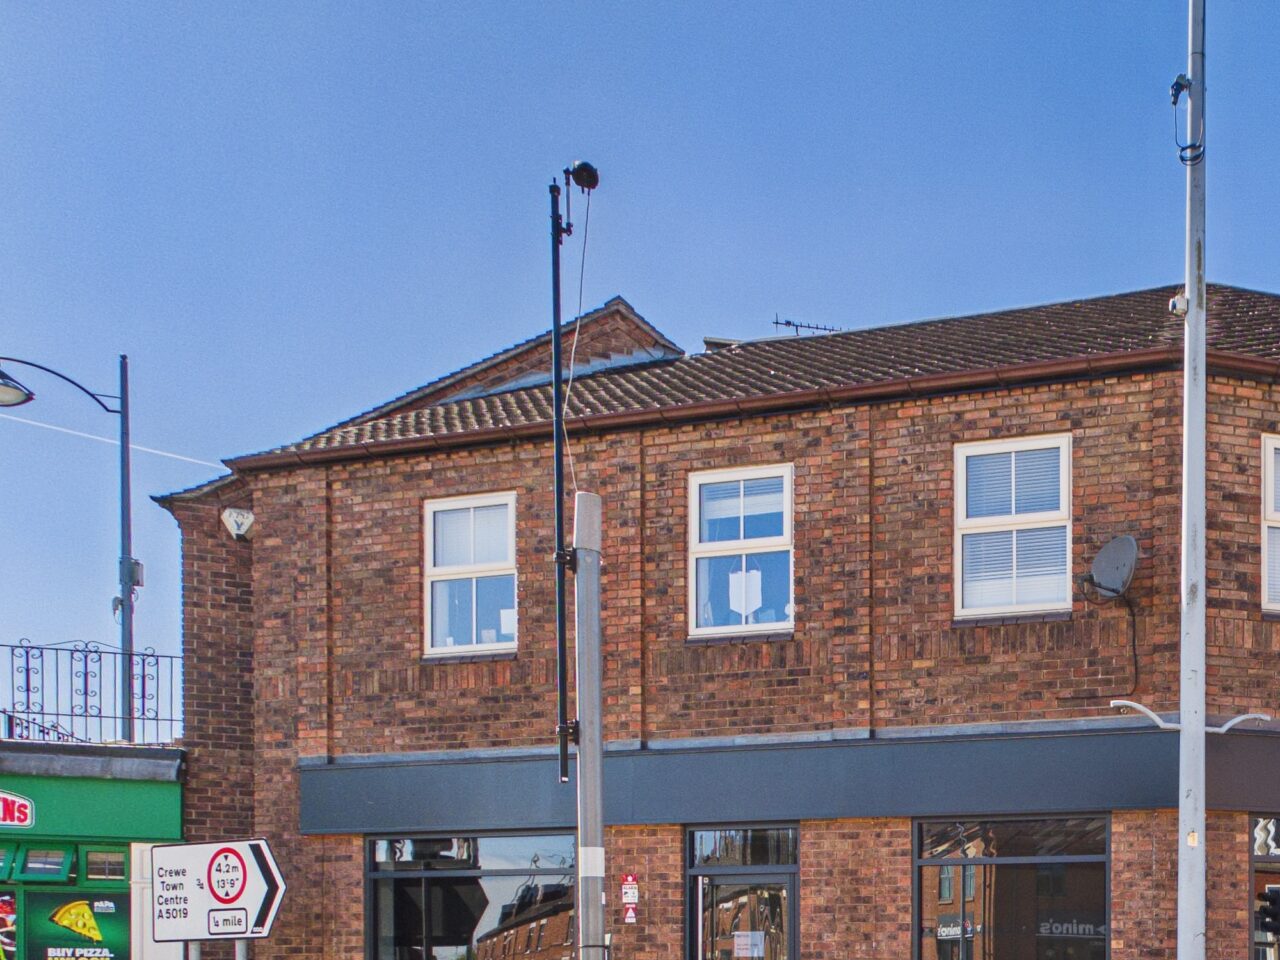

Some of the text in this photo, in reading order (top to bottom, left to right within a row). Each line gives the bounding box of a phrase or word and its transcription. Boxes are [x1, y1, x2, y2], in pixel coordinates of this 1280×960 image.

[157, 867, 187, 878] Crewe
[160, 881, 184, 891] Town
[157, 894, 189, 905] Centre
[222, 915, 243, 927] mile
[47, 947, 114, 957] BUY PIZZA.
